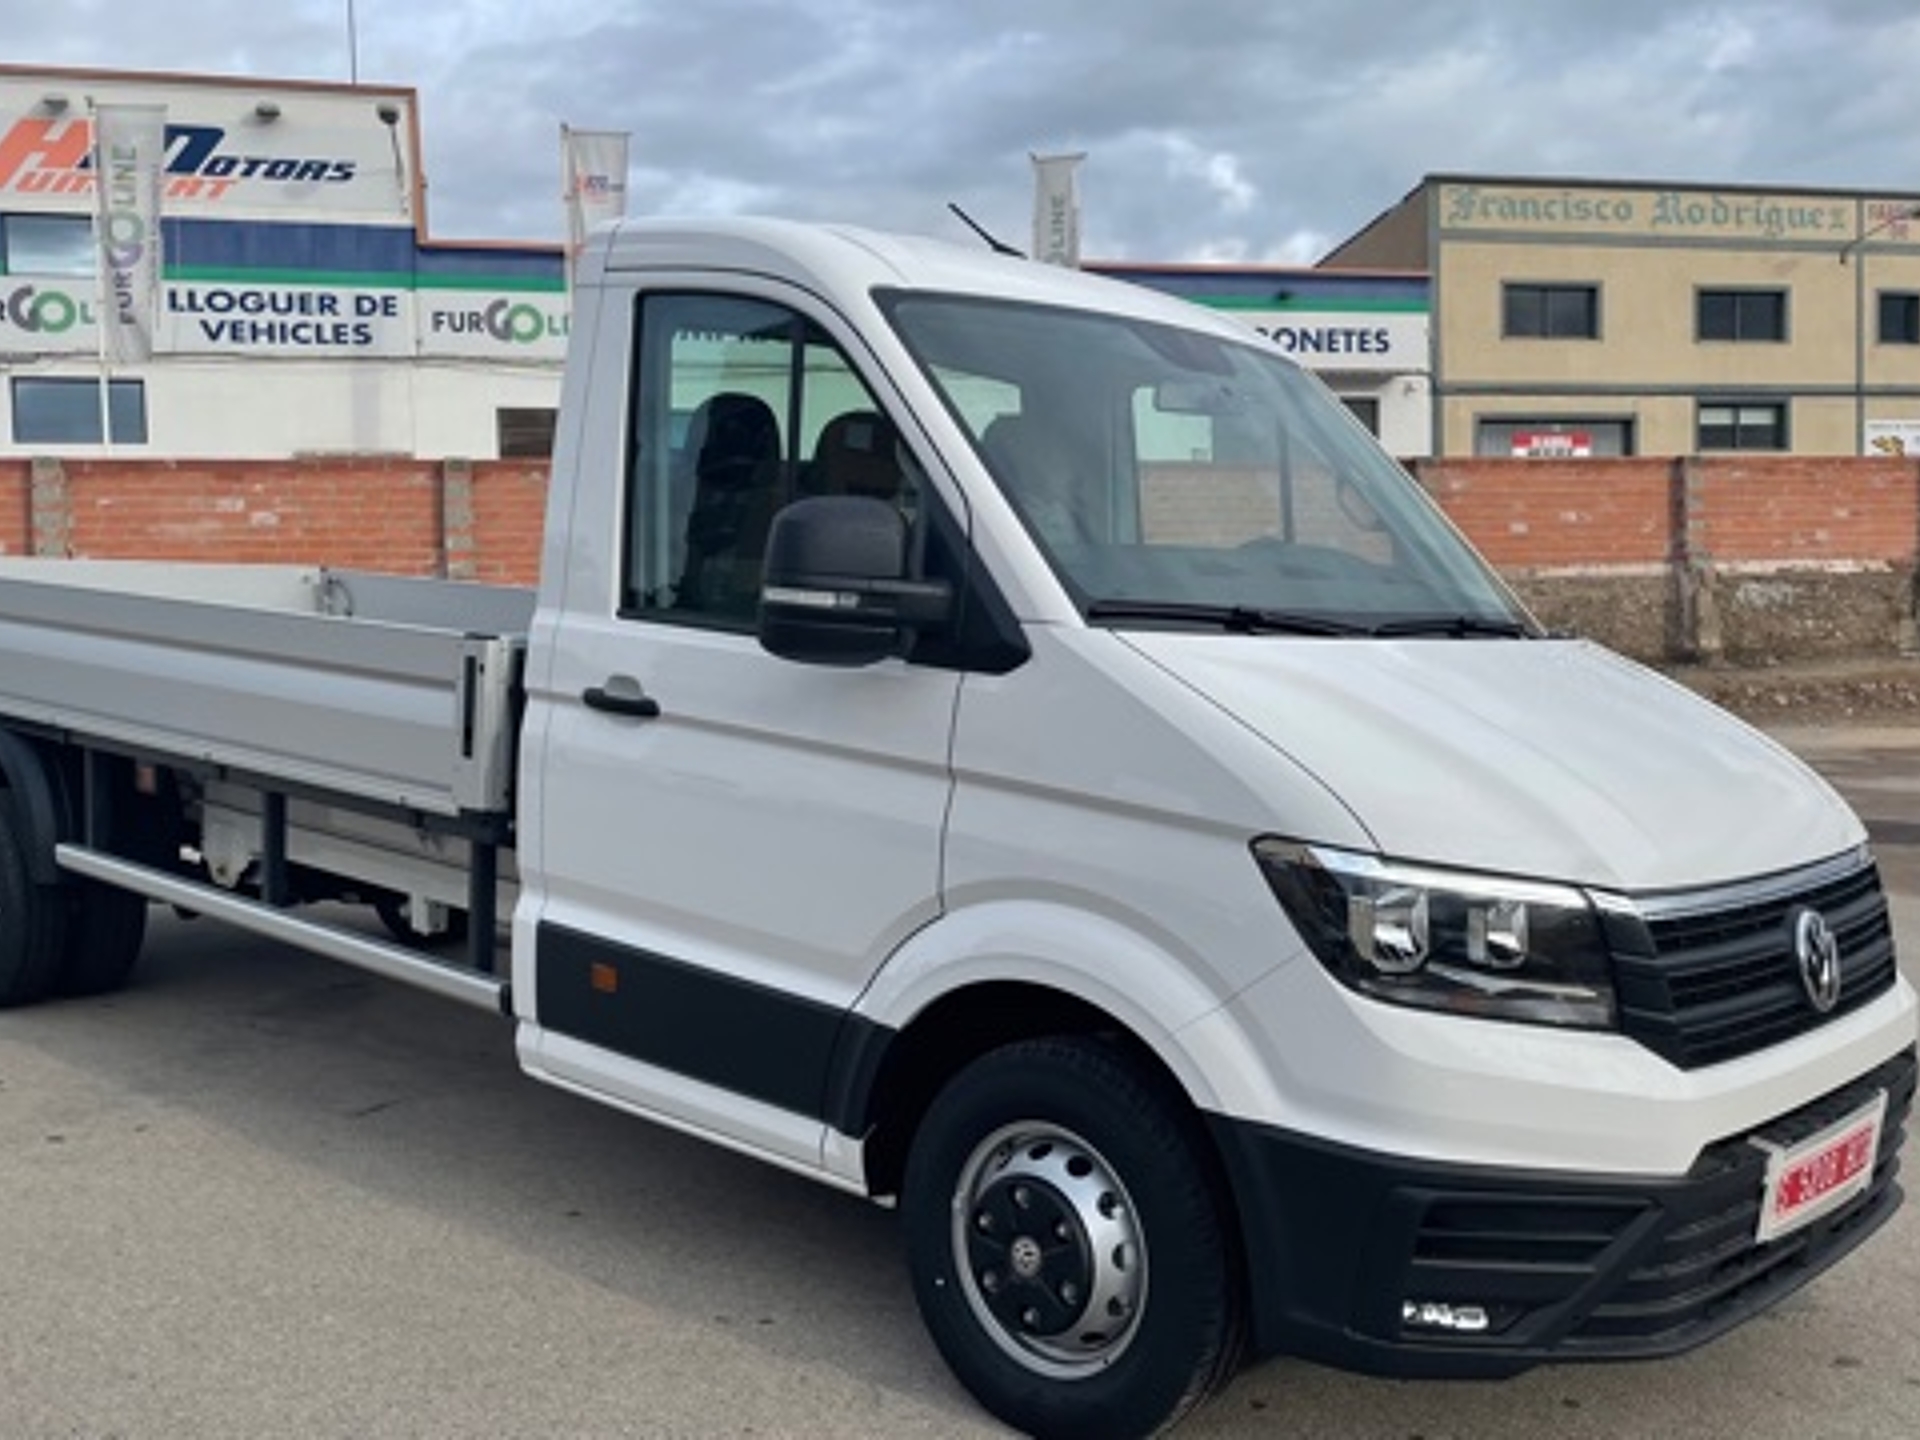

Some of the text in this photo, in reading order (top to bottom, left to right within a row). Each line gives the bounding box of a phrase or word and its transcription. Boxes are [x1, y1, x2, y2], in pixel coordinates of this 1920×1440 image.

[1447, 185, 1634, 225] Francisco
[167, 288, 398, 317] LLOGUER DE
[200, 319, 374, 346] VEHICLES
[1255, 327, 1390, 353] ONETES
